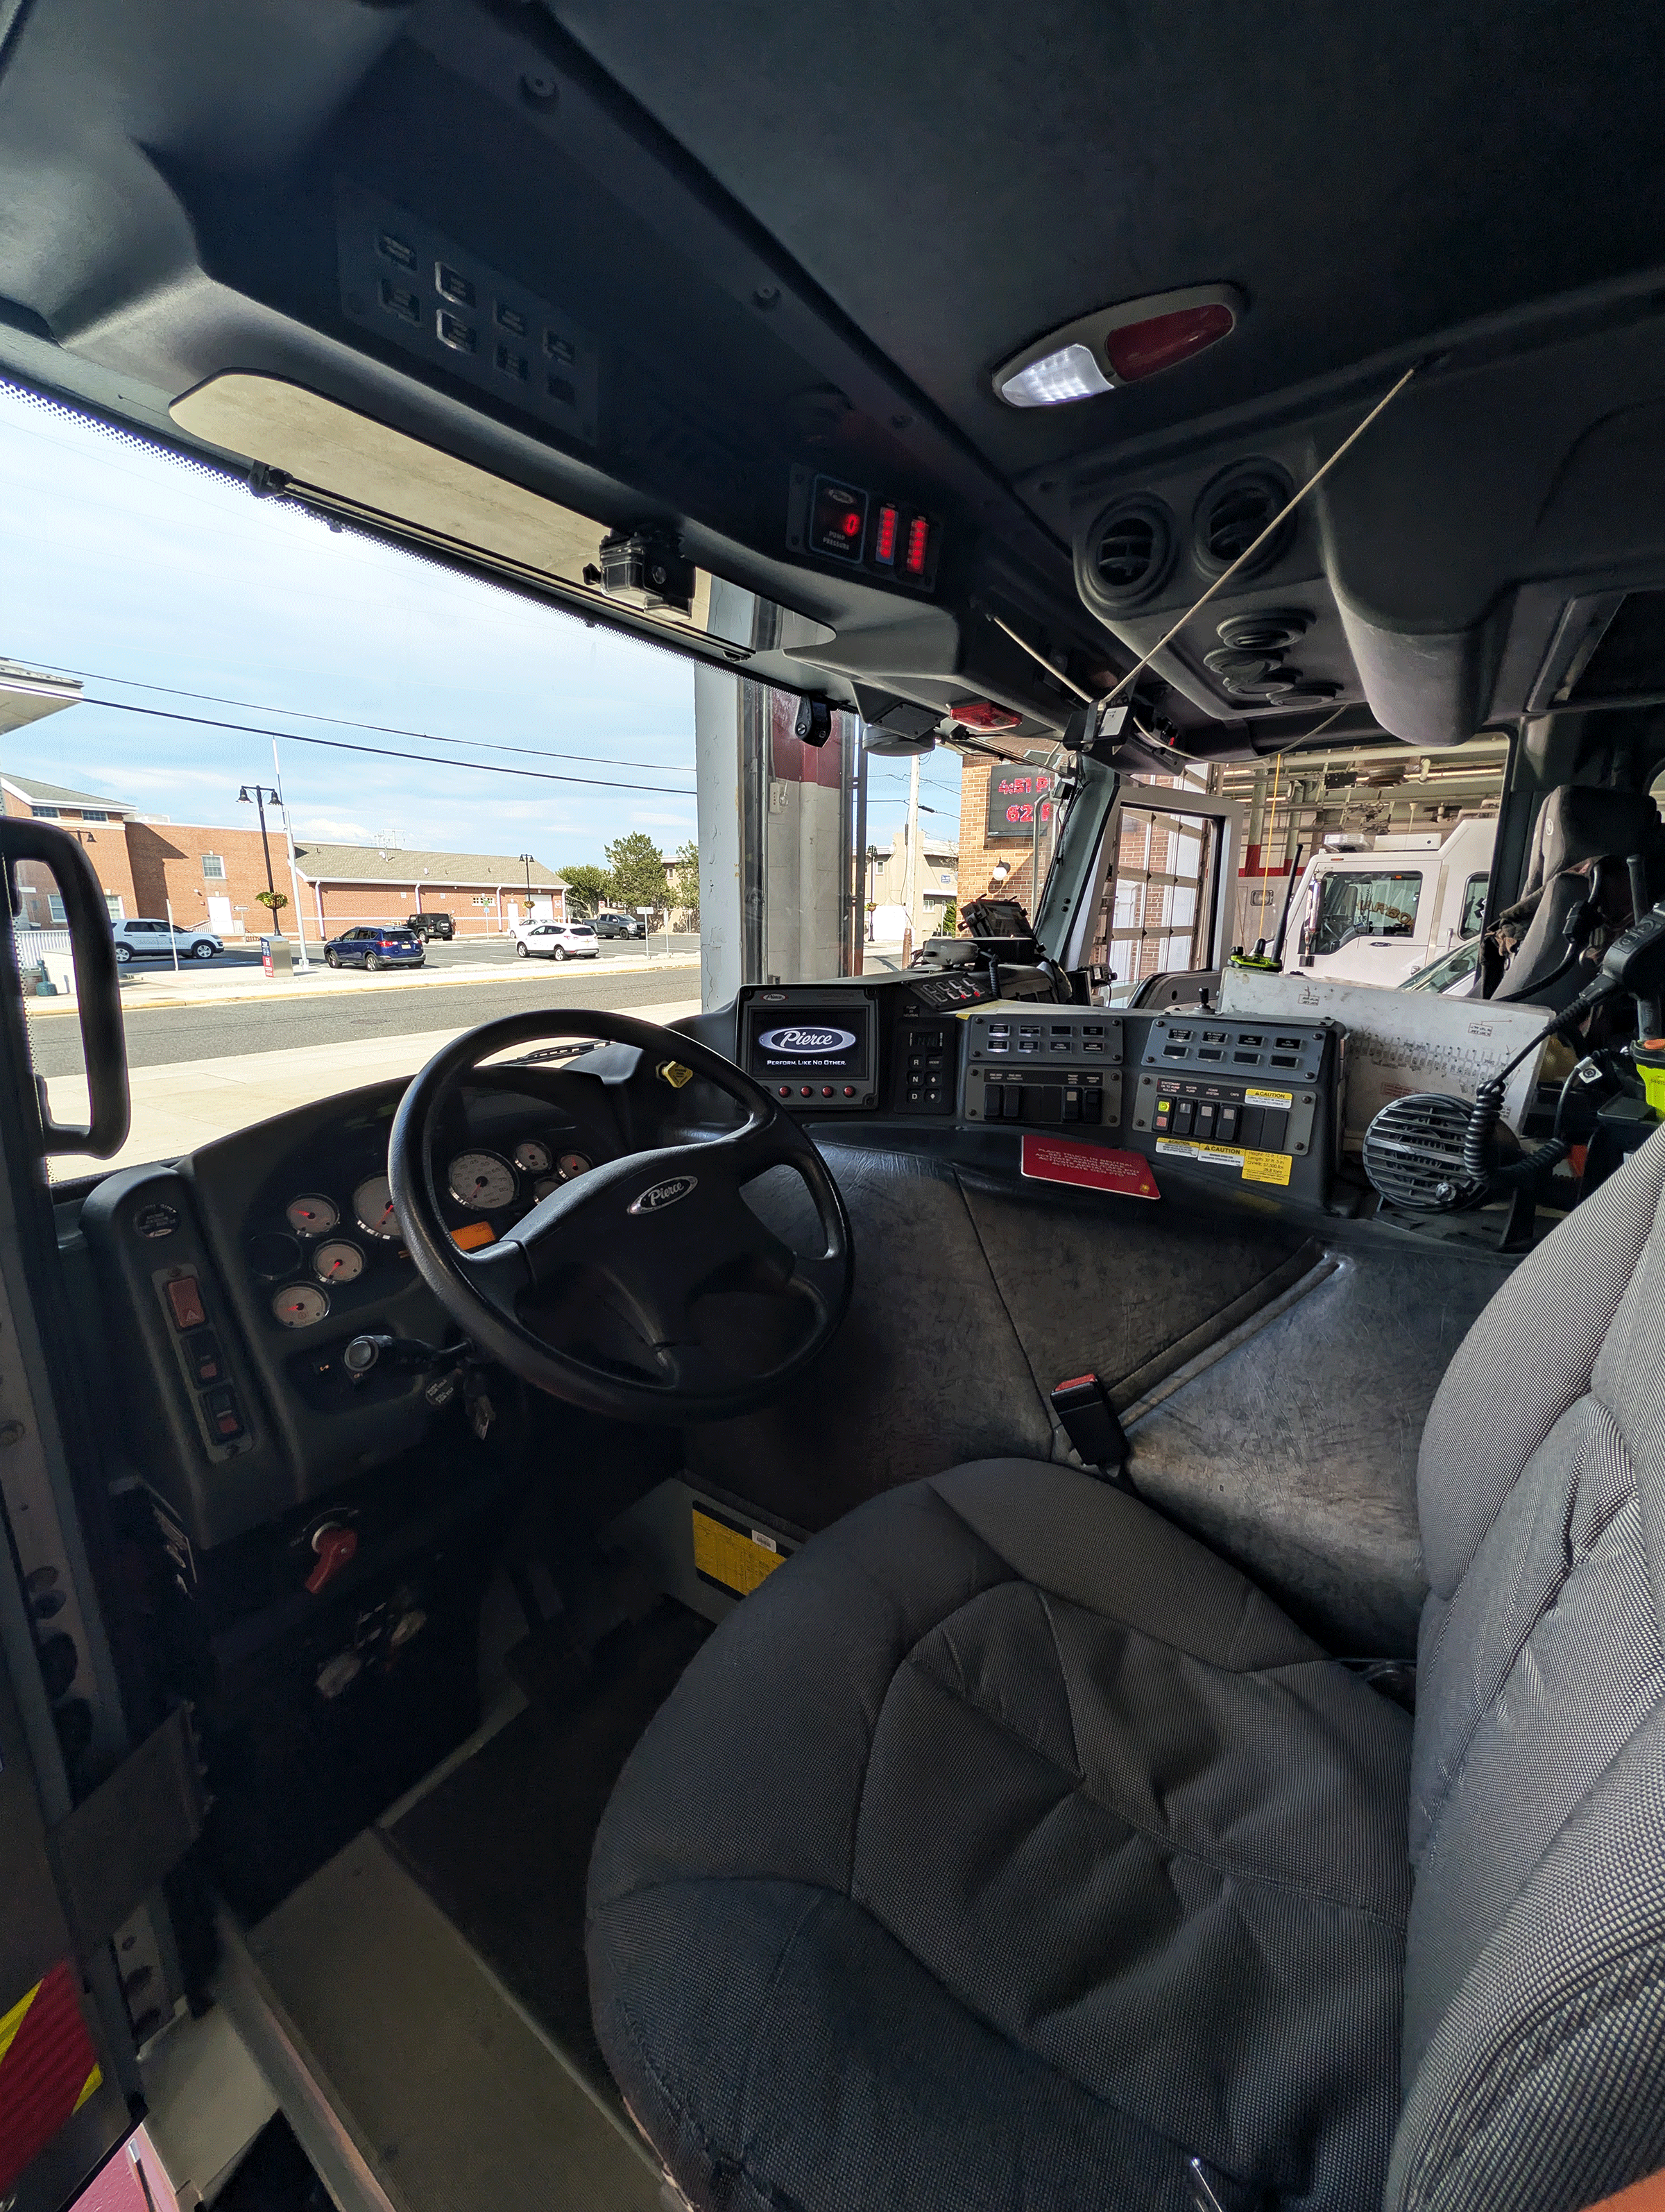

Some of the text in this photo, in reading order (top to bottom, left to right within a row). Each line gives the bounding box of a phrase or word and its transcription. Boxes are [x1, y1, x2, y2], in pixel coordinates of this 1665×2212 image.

[828, 530, 846, 541] PUMP
[823, 536, 850, 551] PRESSURE
[780, 1030, 833, 1048] Pierce
[1211, 1146, 1240, 1155] CAUTION
[648, 1182, 685, 1206] Pierce
